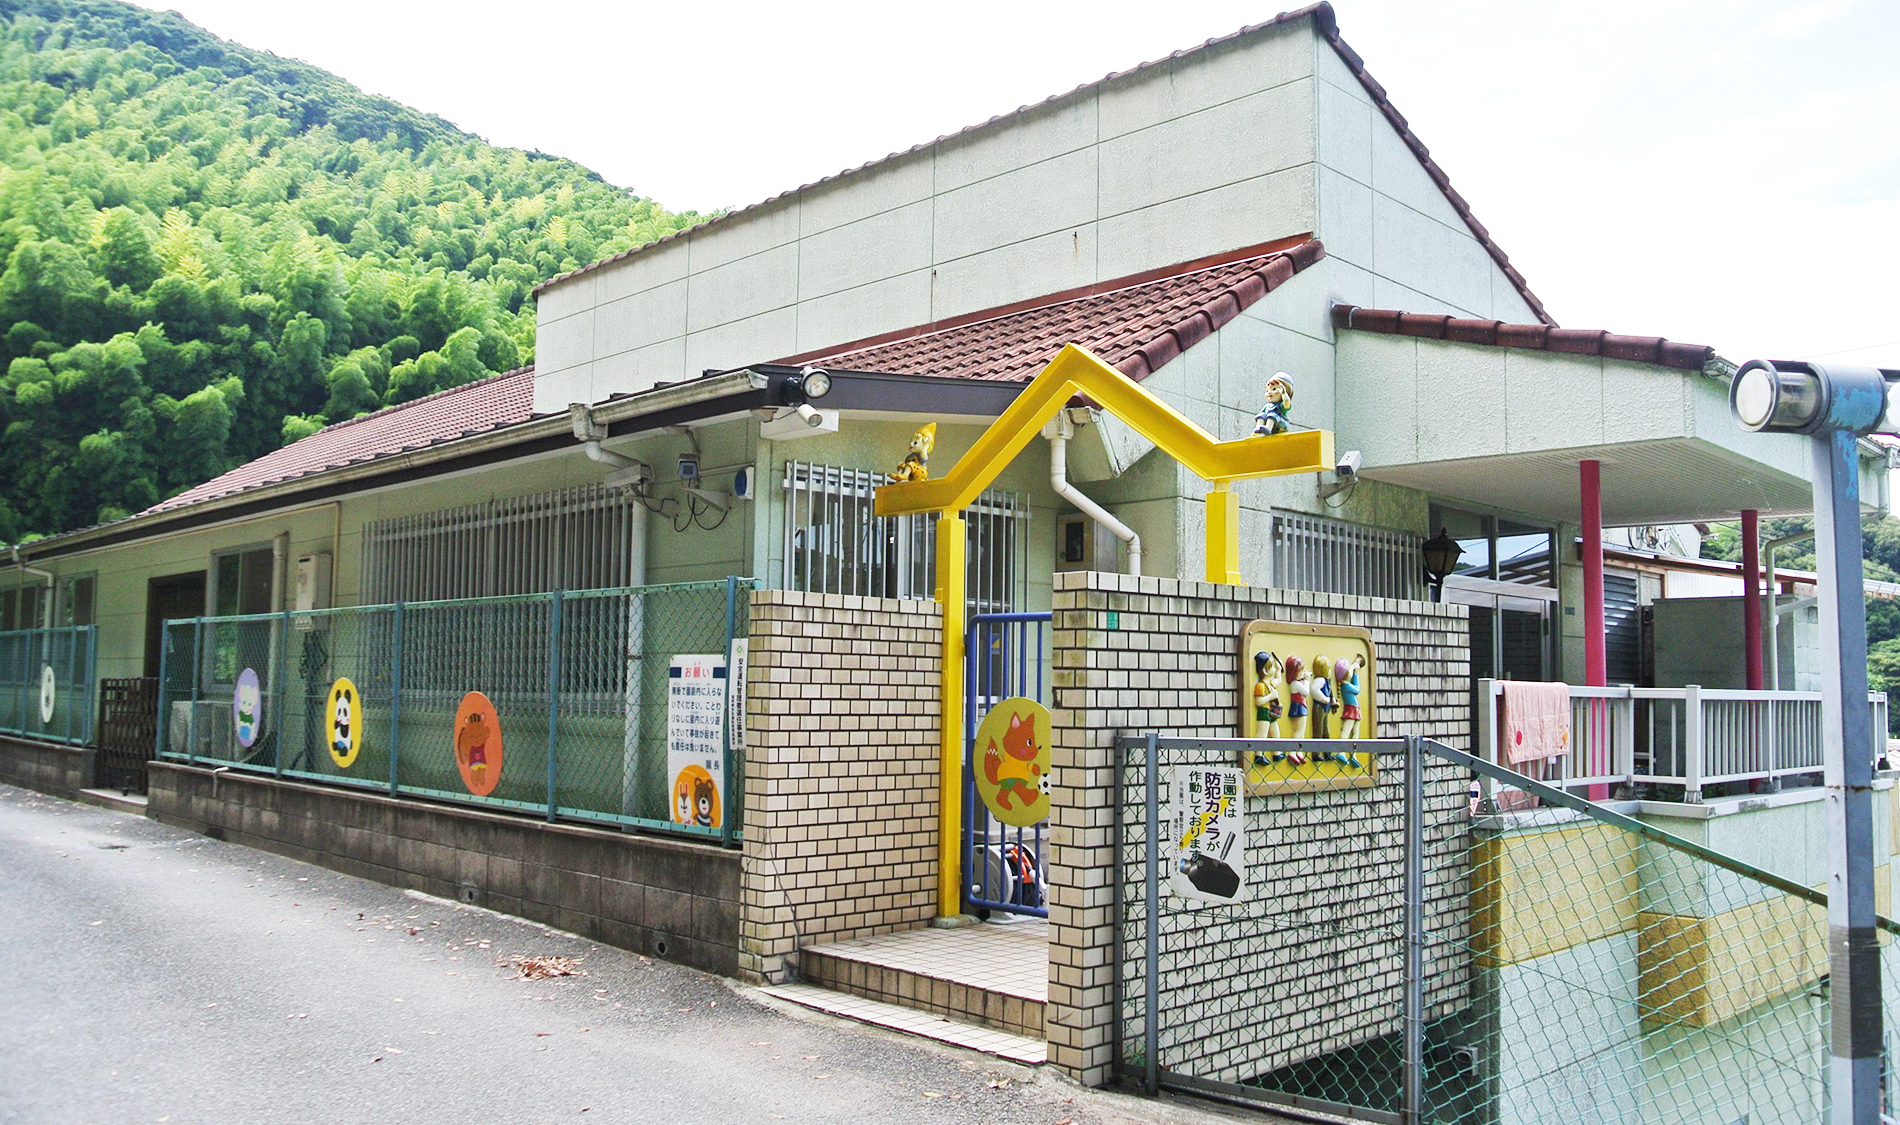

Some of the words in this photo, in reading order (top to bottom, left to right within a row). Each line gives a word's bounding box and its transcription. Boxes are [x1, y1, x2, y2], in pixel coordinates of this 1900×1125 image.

[685, 666, 710, 678] お願い
[1188, 770, 1203, 866] 作動しております。
[1204, 772, 1222, 852] 防犯カメラが
[1223, 773, 1237, 818] 当園では
